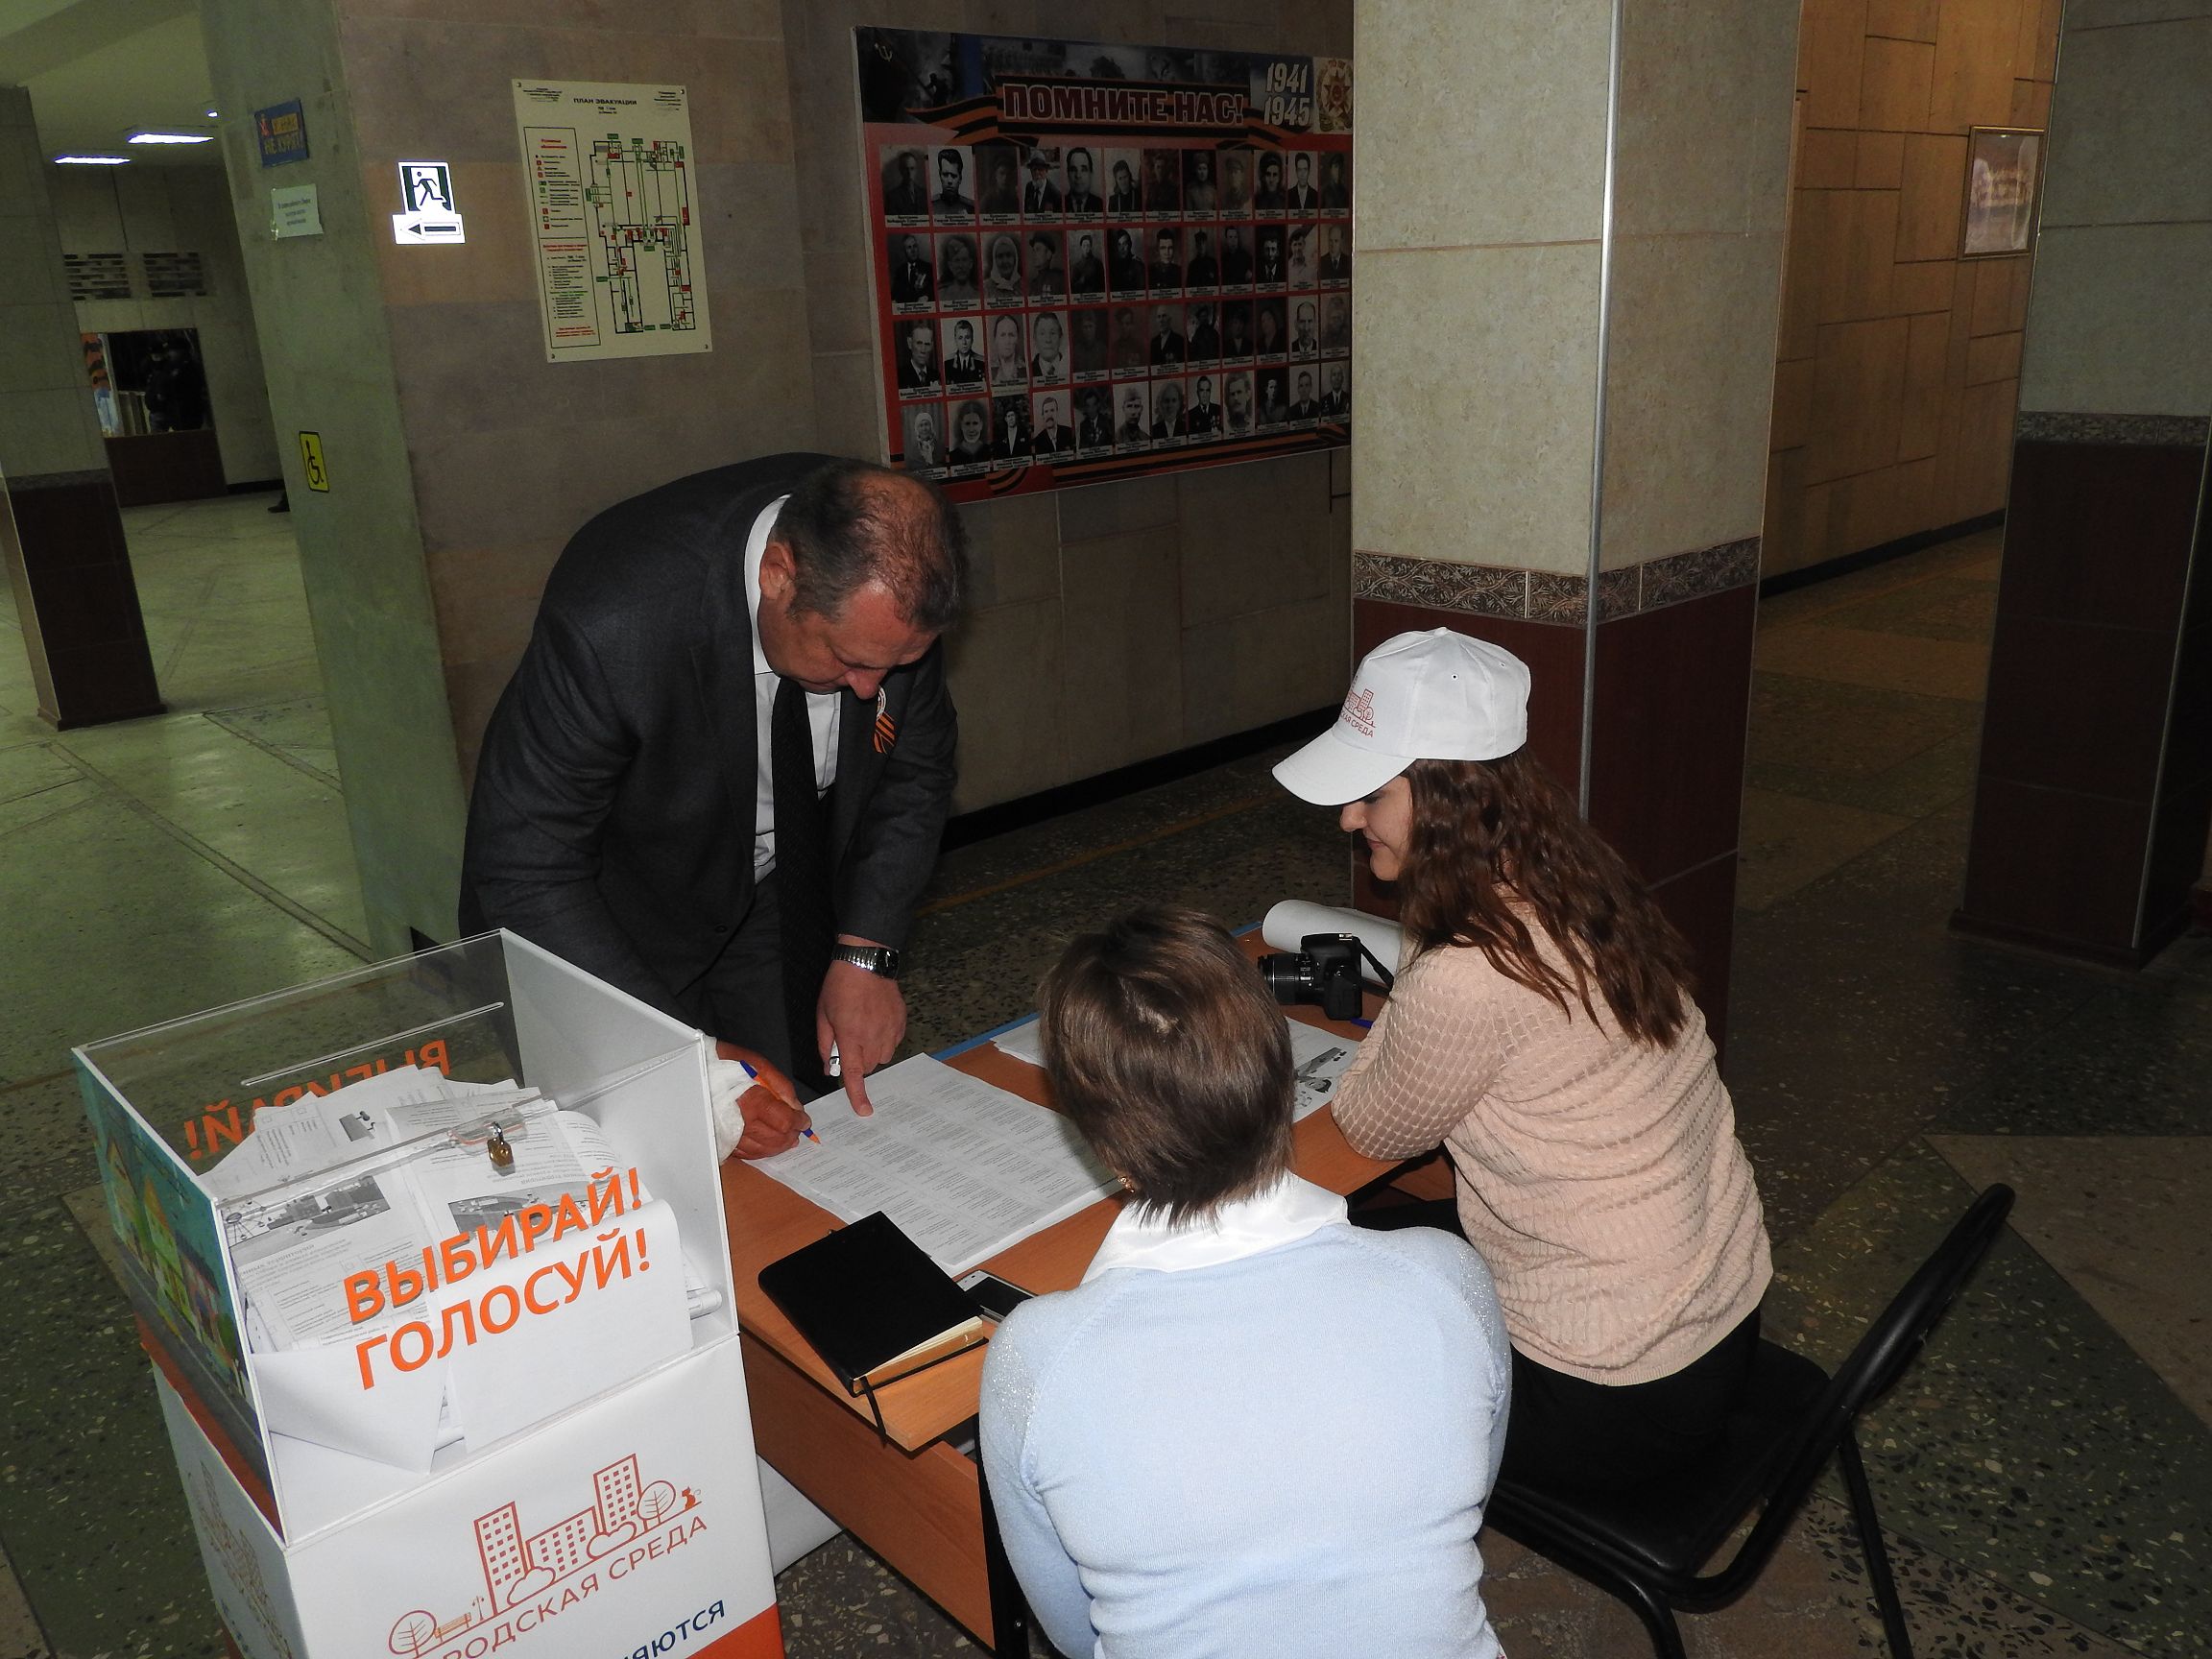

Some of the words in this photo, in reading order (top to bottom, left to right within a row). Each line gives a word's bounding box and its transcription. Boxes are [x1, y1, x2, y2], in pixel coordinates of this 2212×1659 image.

[1265, 62, 1307, 94] 1941
[1002, 83, 1168, 123] ПОМНИТЕ
[1173, 91, 1244, 126] НАС!
[1263, 96, 1310, 127] 1945
[1351, 719, 1374, 737] СРЕДА
[343, 1166, 643, 1325] ВЫБИРАЙ!
[355, 1228, 652, 1389] ГОЛОСУЙ!
[609, 1516, 708, 1580] СРЕДА
[624, 1599, 726, 1659] ЯЮТСЯ
